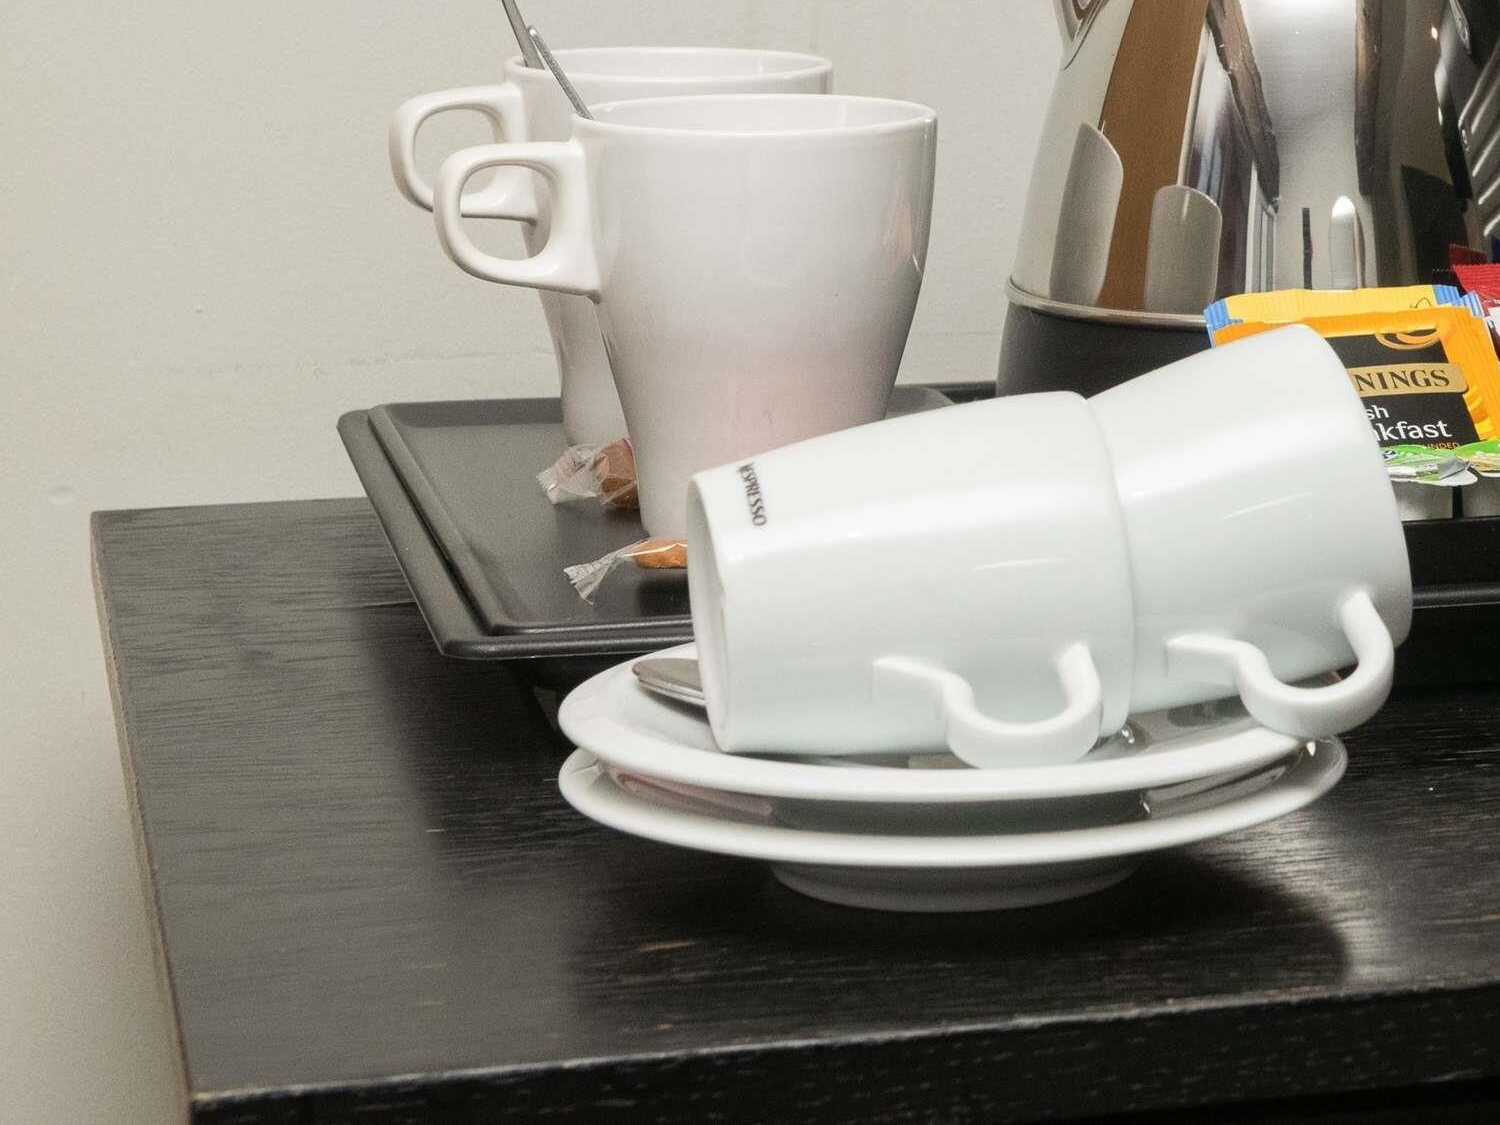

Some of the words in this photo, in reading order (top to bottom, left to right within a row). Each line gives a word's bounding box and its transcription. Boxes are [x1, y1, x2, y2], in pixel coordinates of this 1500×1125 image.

[1352, 369, 1450, 392] NINGS
[1374, 420, 1453, 442] kfast
[736, 462, 768, 527] NESPRESSO
